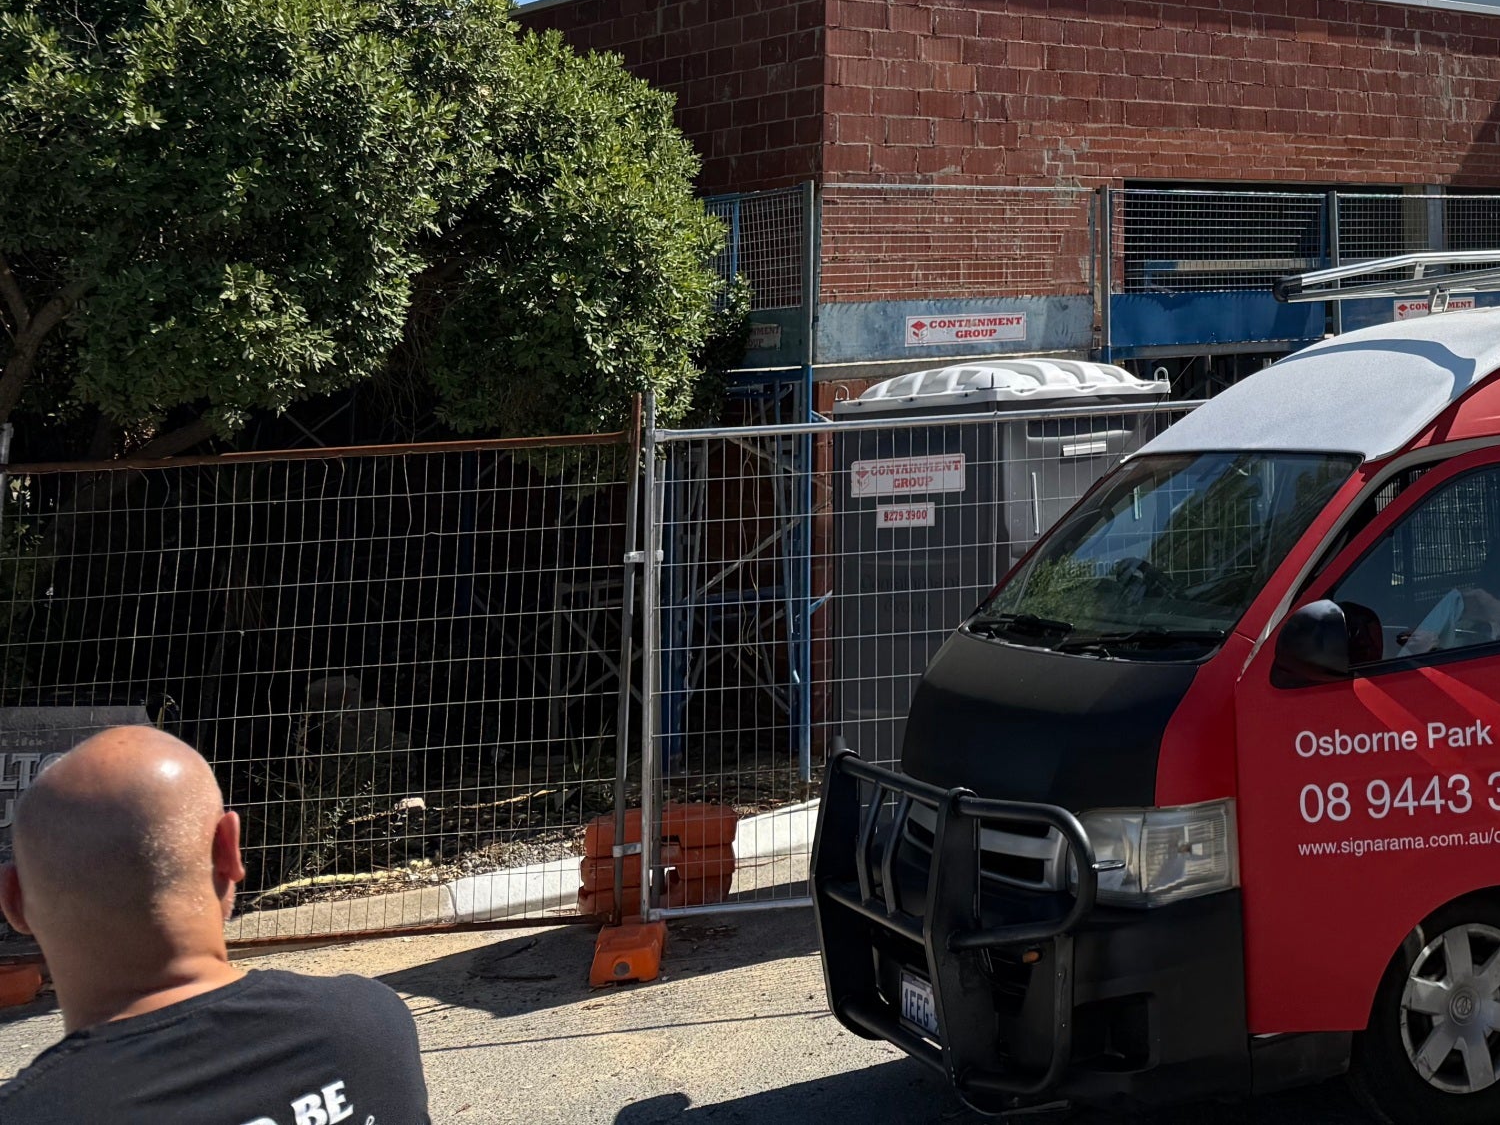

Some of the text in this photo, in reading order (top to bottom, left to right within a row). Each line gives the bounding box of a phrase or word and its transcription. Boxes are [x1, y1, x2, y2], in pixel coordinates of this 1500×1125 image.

[1409, 301, 1472, 311] CONMENT
[955, 328, 997, 339] GROUP
[870, 460, 961, 476] CONTAINMENT
[894, 476, 934, 488] GROUP
[884, 509, 904, 522] 9279
[1295, 719, 1493, 758] Osborne Park
[1300, 782, 1351, 823] 08
[1366, 774, 1473, 820] 9443
[290, 1080, 353, 1125] BE
